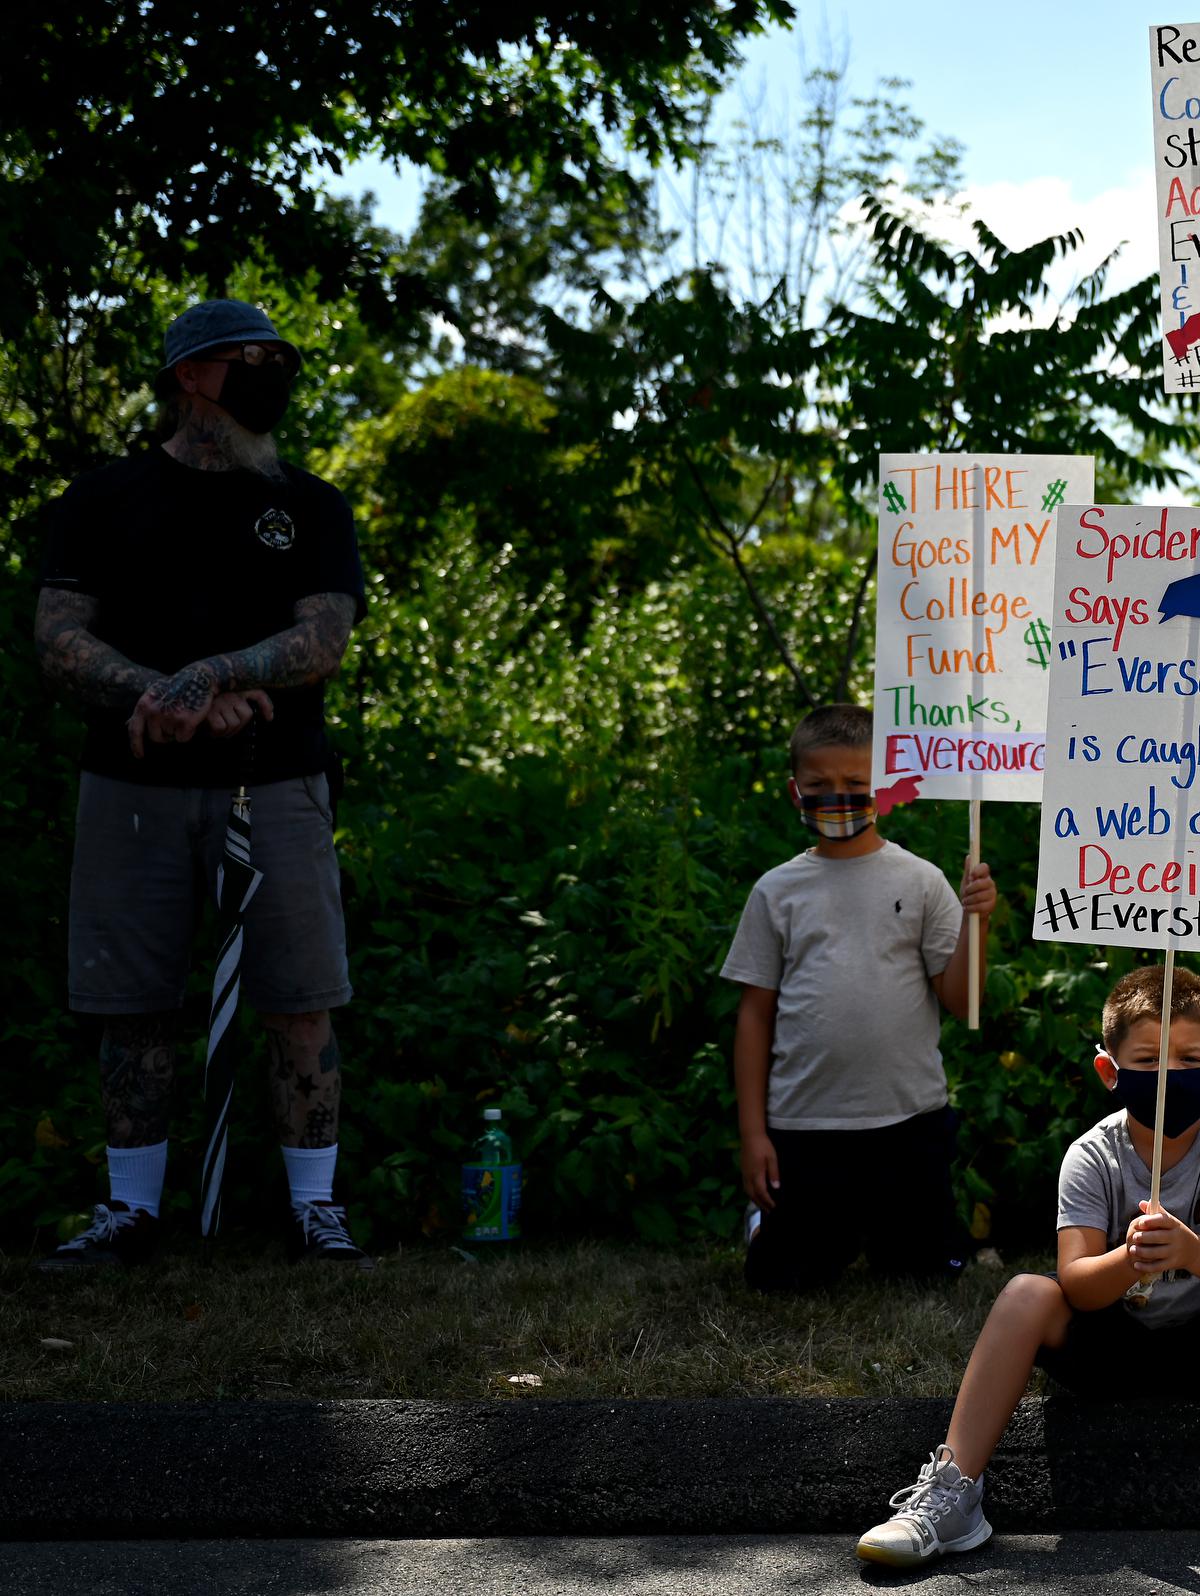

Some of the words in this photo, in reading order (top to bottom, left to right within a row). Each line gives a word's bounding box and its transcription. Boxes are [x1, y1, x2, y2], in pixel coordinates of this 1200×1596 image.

[888, 463, 1029, 513] THERE
[891, 521, 972, 578] Goes
[990, 519, 1051, 565] MY
[900, 576, 1032, 634] College
[882, 684, 1022, 732] Thanks,
[885, 734, 1046, 775] Eversourc
[1068, 724, 1101, 762] is
[1054, 807, 1080, 838] a
[1096, 785, 1171, 840] web
